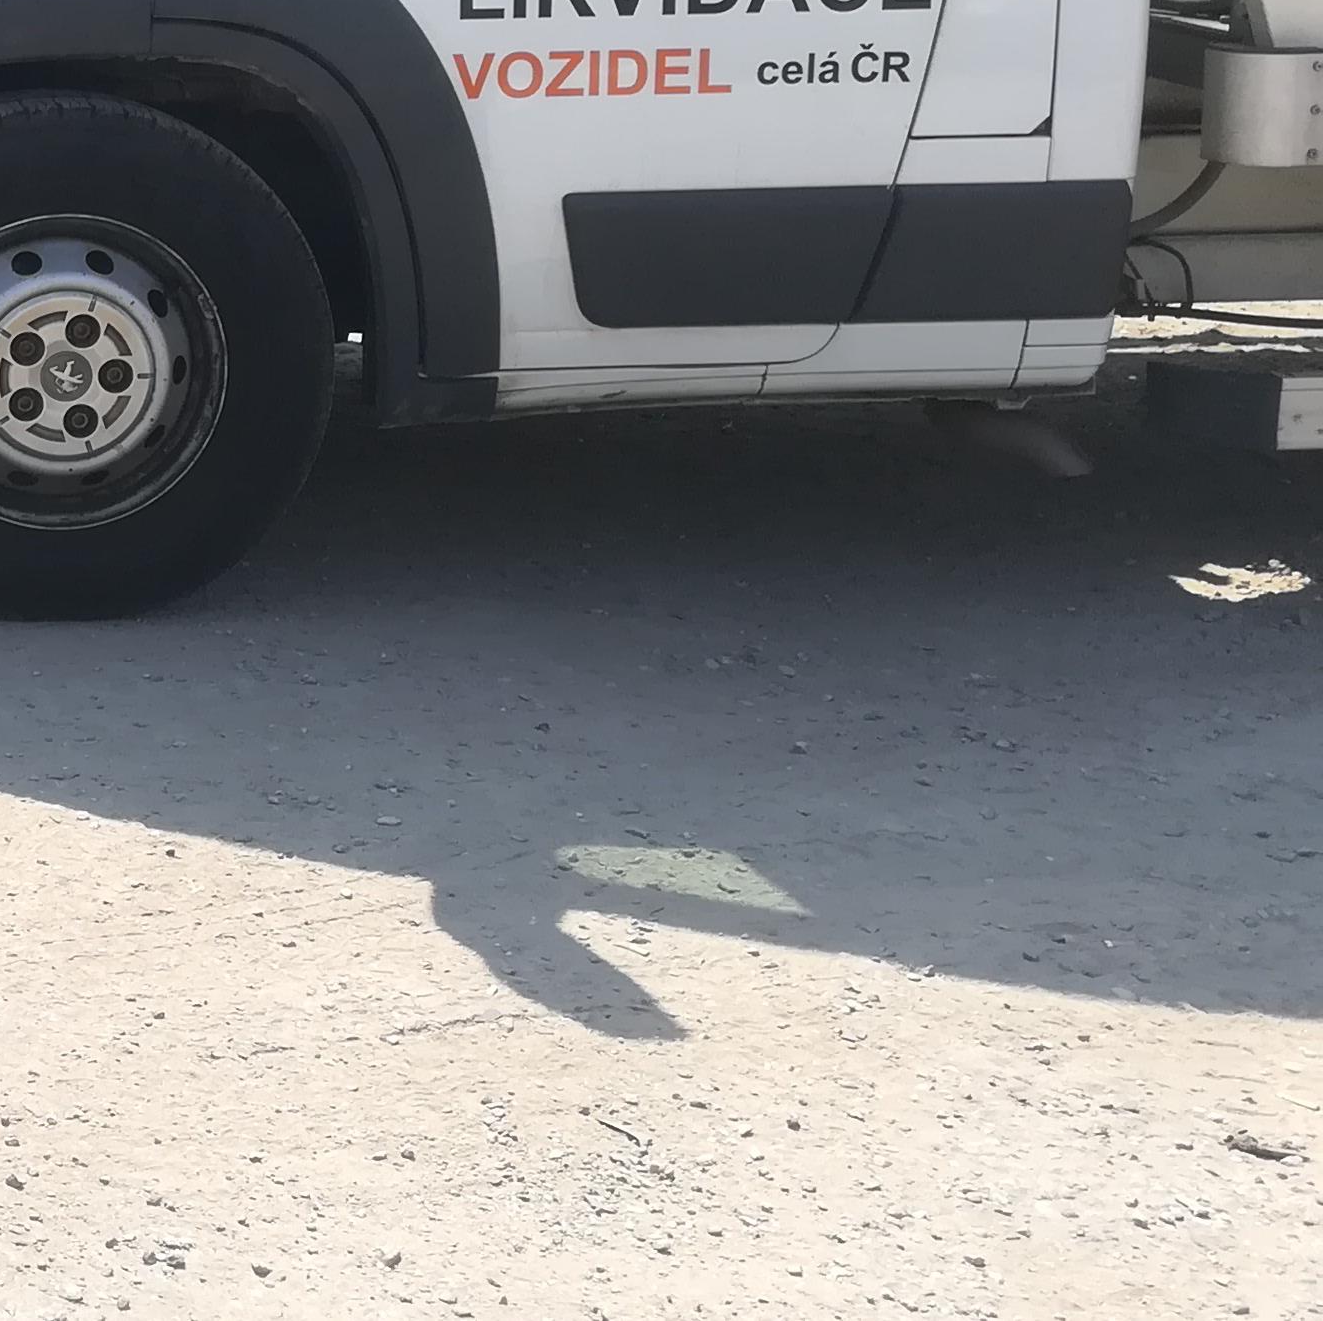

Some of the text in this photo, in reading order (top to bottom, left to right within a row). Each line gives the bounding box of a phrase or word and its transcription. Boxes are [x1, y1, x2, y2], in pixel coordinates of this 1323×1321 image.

[452, 43, 911, 100] VOZIDEL celá ČR
